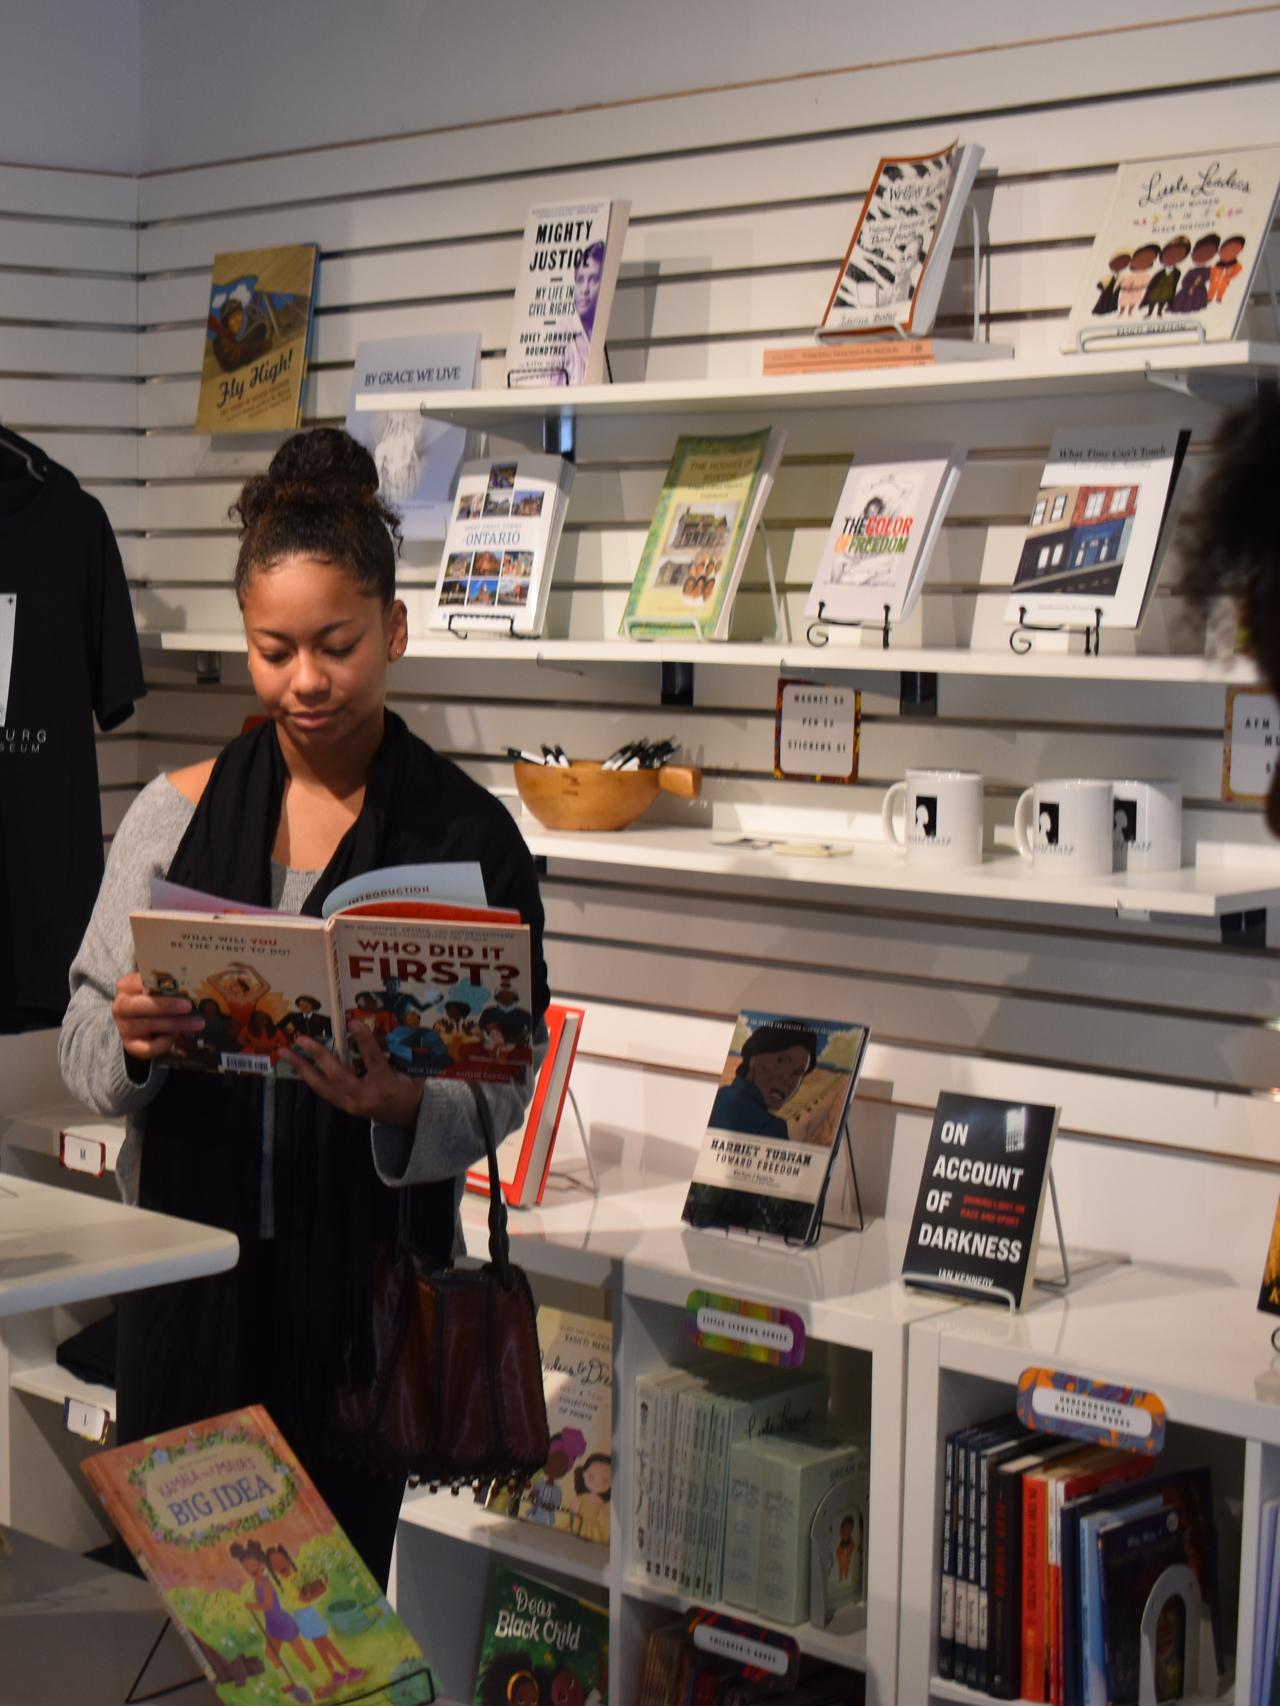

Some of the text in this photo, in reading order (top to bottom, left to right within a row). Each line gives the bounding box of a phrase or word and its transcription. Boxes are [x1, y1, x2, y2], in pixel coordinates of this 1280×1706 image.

[536, 220, 593, 244] MIGHTY
[530, 247, 593, 272] JUSTICE
[535, 286, 574, 299] MY LIFE IN
[528, 302, 576, 316] CIVIL RIGHTS
[544, 332, 577, 342] JOHNSON
[217, 377, 244, 408] Fly
[249, 348, 293, 388] High!
[364, 366, 461, 387] BY GRACE WE LIVE
[843, 515, 913, 537] THE COLOR
[466, 531, 521, 546] ONTARIO
[835, 534, 909, 555] OF FREEDOM
[794, 694, 829, 705] MAGNET
[802, 717, 819, 727] PEN
[1245, 717, 1270, 730] AFM
[788, 740, 832, 752] STICKERS
[348, 885, 430, 905] INTRODUCTION
[181, 933, 277, 946] WHAT WILL YOU
[188, 942, 210, 950] THE
[214, 944, 246, 952] FIRST
[250, 946, 265, 954] TO
[357, 939, 504, 960] WHO DID IT
[349, 955, 520, 989] FIRST?
[940, 1120, 969, 1146] ON
[710, 1138, 812, 1166] HARRIET TUBMAN
[715, 1153, 801, 1177] TOWARD FREEDOM
[932, 1154, 1024, 1191] ACCOUNT
[925, 1188, 952, 1214] OF
[918, 1222, 1023, 1264] DARKNESS
[167, 1474, 276, 1526] BIG IDEA
[514, 1585, 556, 1619] Dear
[495, 1609, 582, 1650] Black Child
